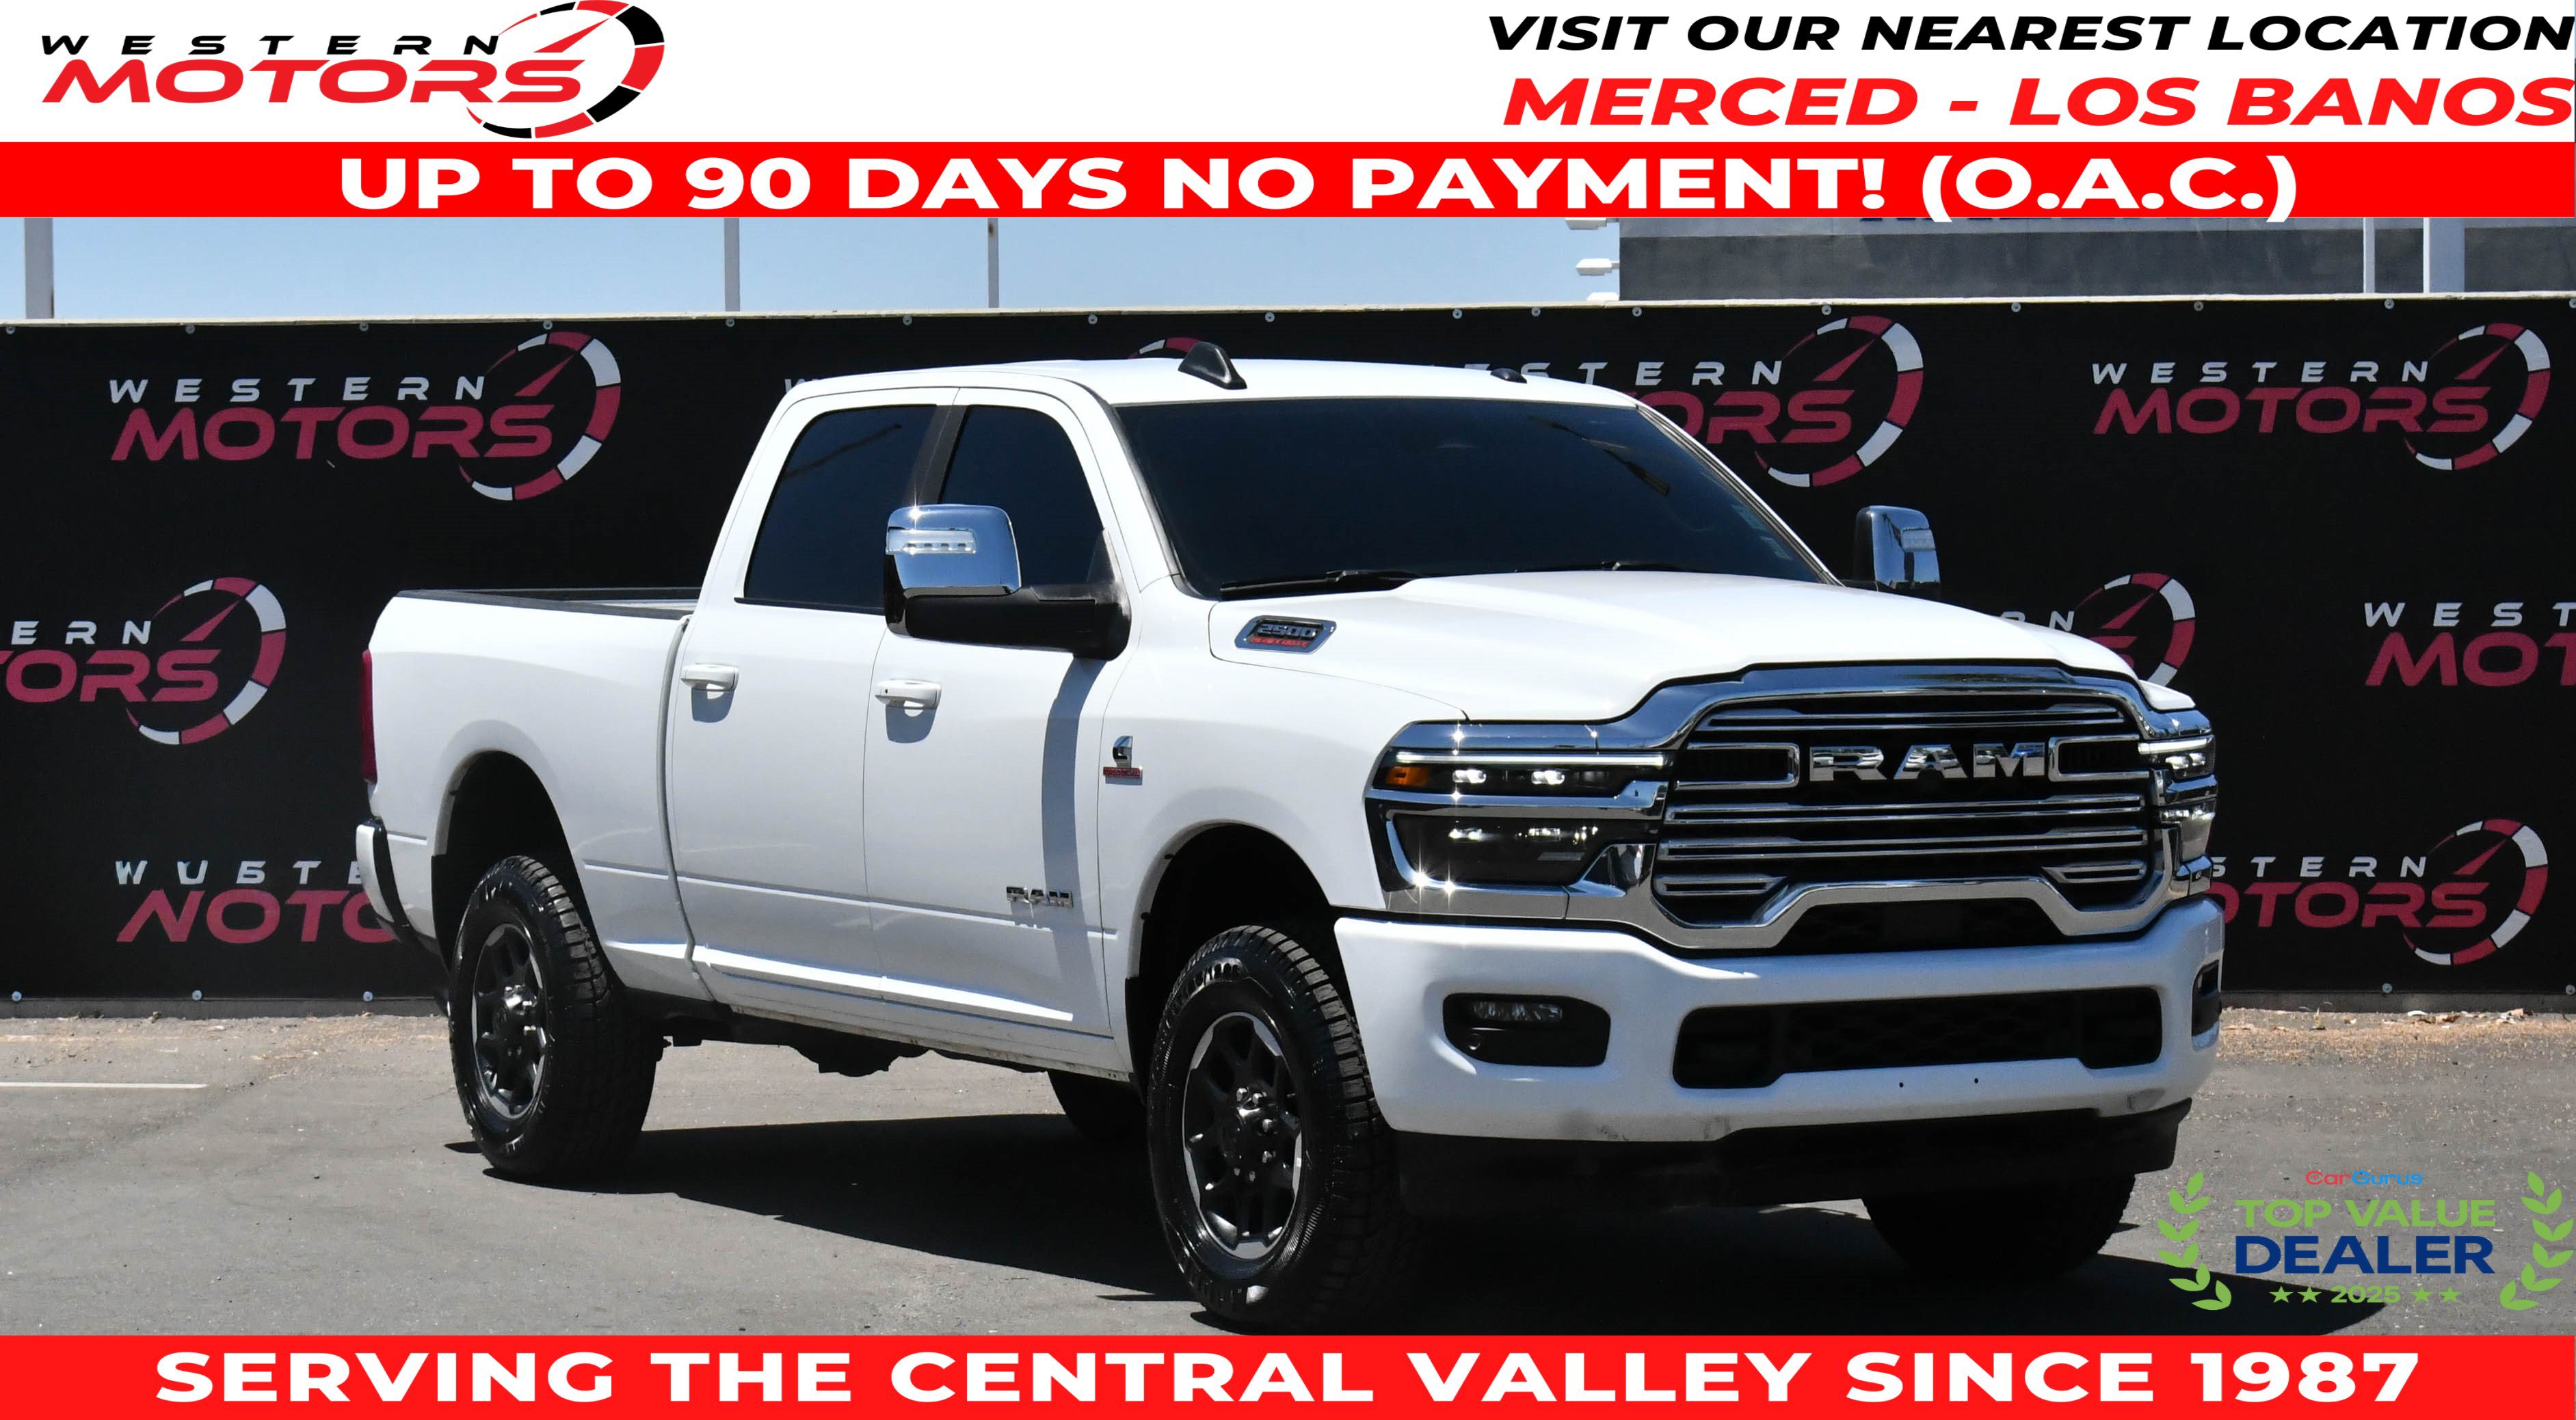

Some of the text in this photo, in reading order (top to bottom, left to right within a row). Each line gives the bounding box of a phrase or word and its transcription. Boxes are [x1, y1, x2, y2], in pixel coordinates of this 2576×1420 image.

[109, 376, 486, 403] WESTERN
[1465, 361, 1781, 387] STERN
[2092, 361, 2428, 385] WESTERN
[1625, 389, 1855, 444] ORS
[2093, 386, 2491, 435] MOTORS
[111, 404, 555, 461] MOTORS
[1809, 742, 2046, 781] RAM
[2209, 856, 2427, 878] STERN
